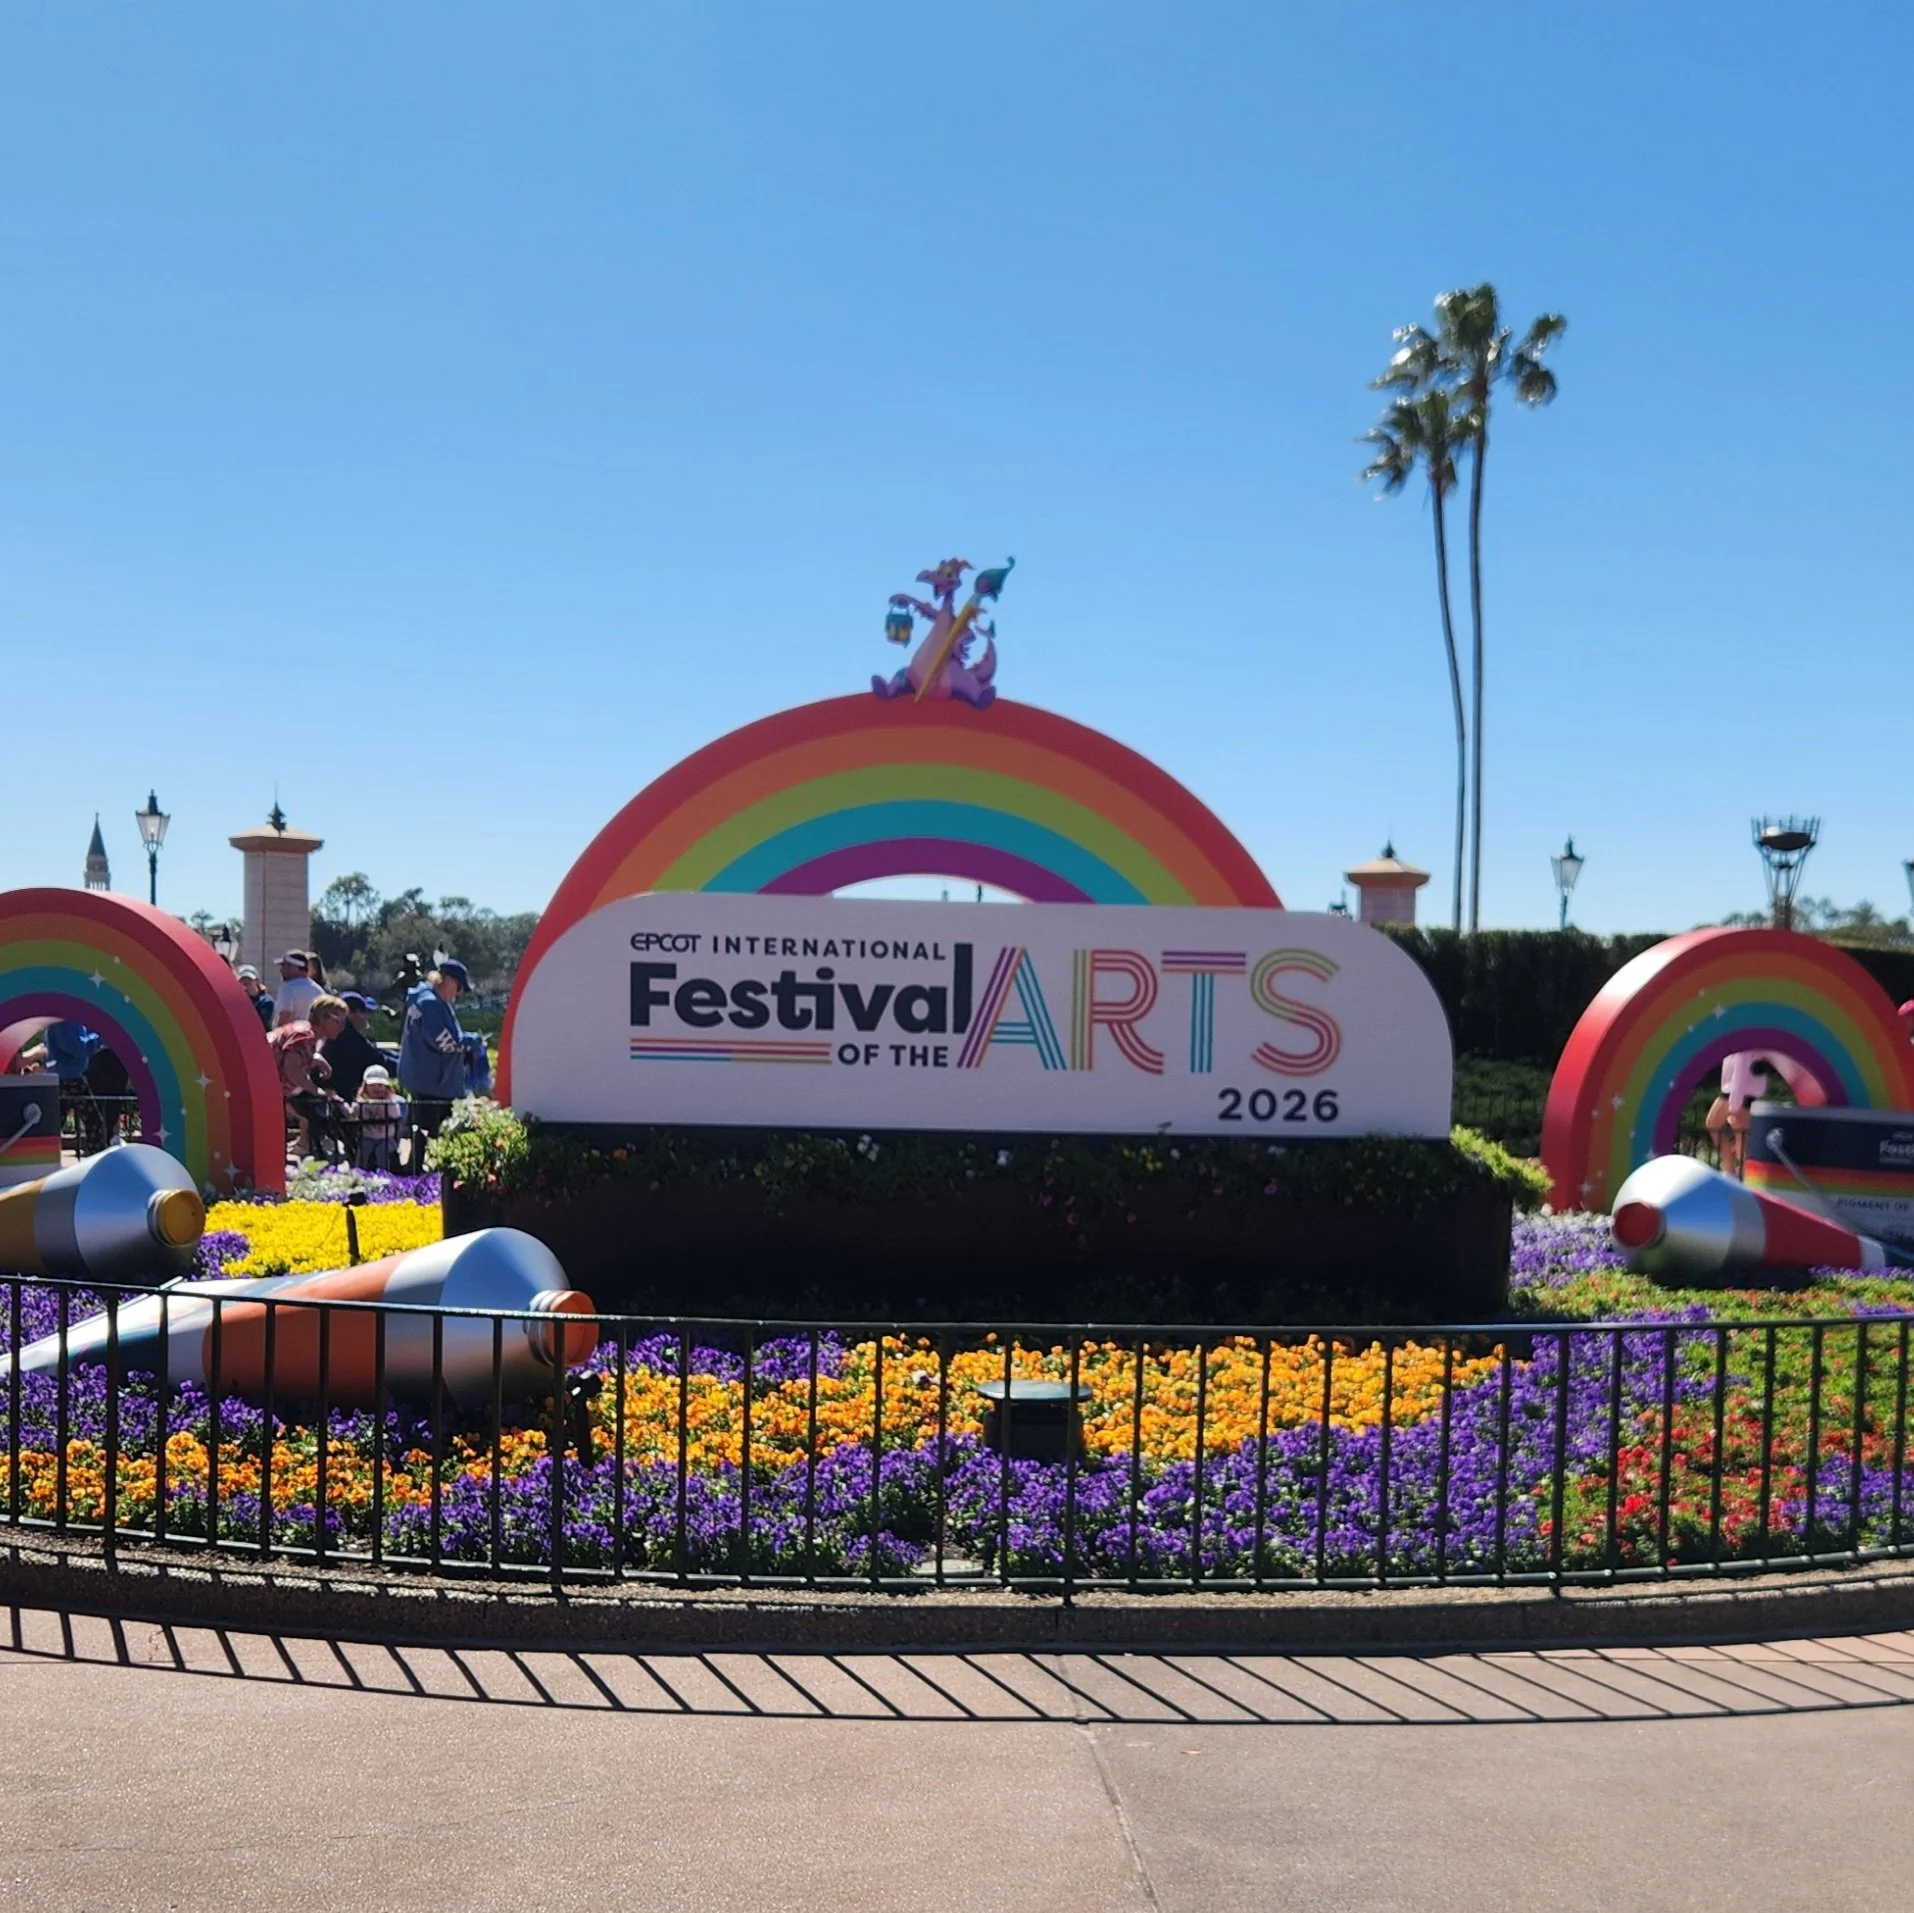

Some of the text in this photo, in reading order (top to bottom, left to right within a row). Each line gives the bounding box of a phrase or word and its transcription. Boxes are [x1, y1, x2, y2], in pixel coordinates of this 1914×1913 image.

[630, 932, 946, 961] EPCOT INTERNATIONAL
[629, 943, 974, 1034] Festival
[956, 947, 1342, 1078] ARTS
[837, 1043, 949, 1068] OF THE
[1217, 1087, 1340, 1123] 2026
